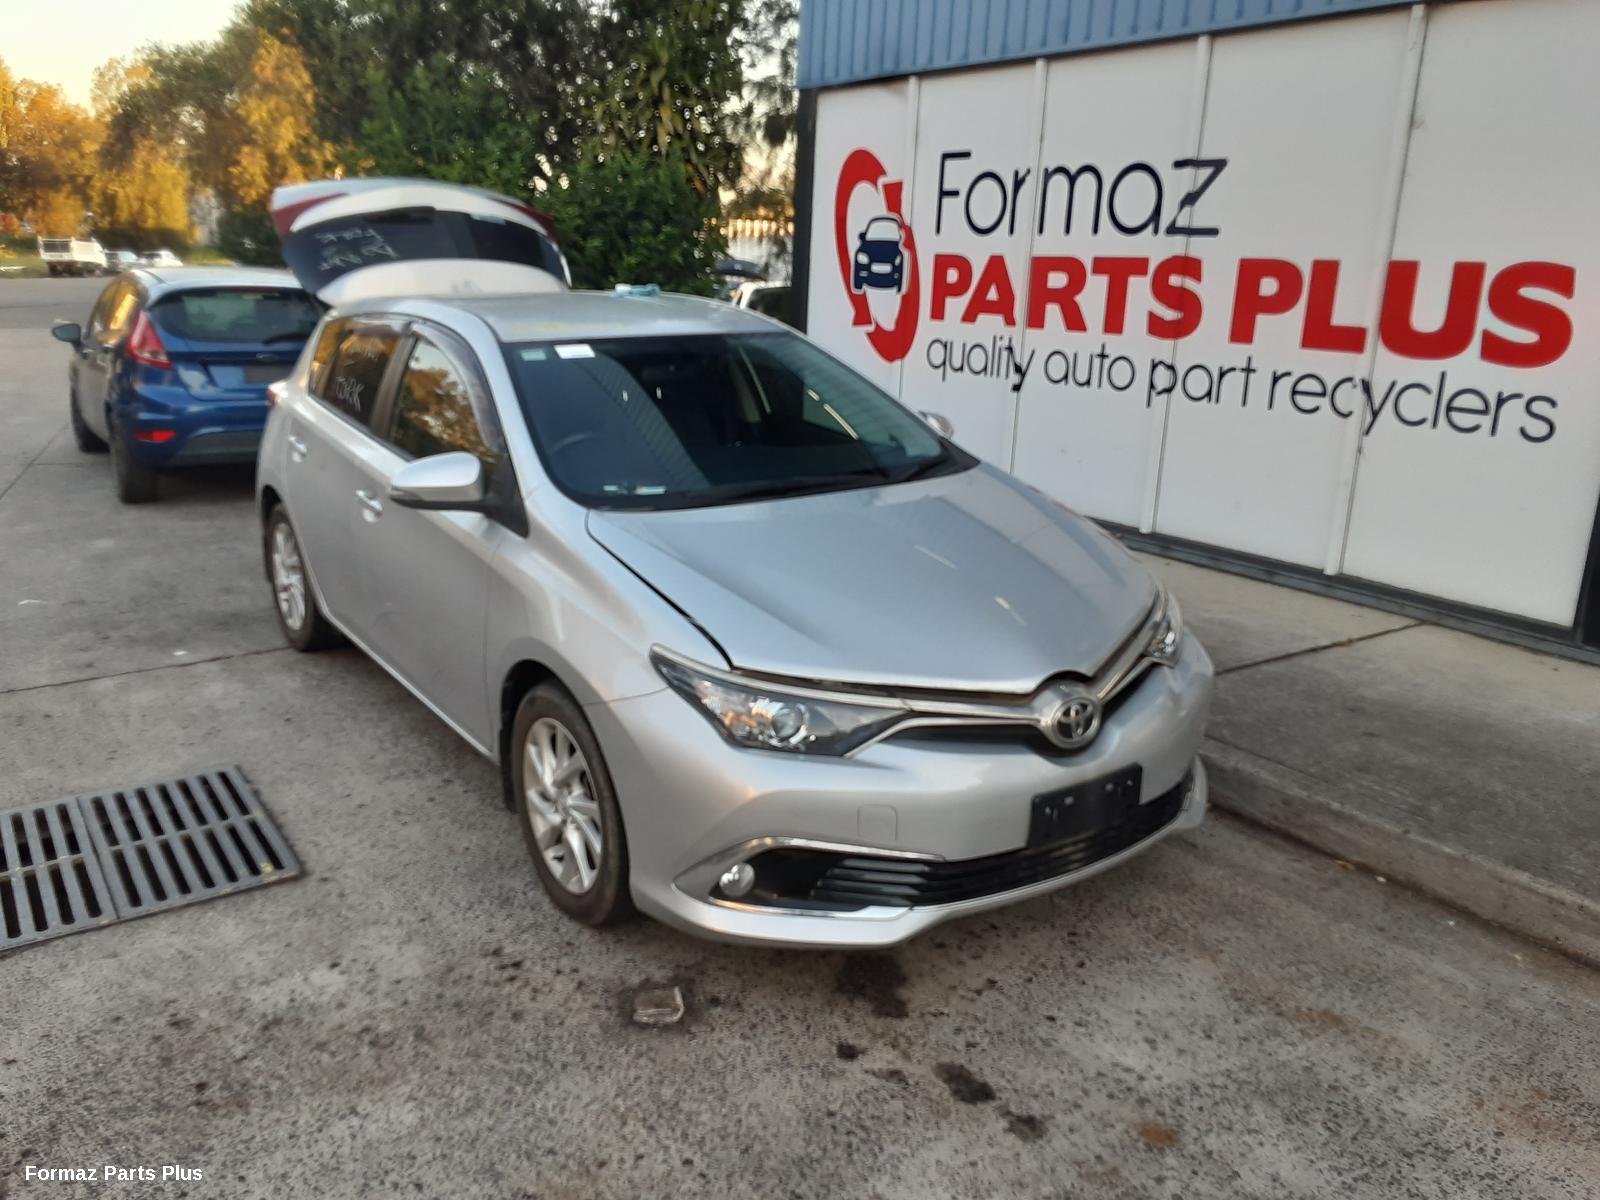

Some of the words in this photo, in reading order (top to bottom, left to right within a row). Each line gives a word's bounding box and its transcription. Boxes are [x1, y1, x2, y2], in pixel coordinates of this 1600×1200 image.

[935, 151, 1229, 237] Formaz
[930, 254, 1203, 340] PARTS
[1229, 258, 1577, 369] PLUS
[926, 335, 1034, 392] quality
[1043, 345, 1136, 392] auto
[1146, 355, 1257, 408] part
[1269, 371, 1558, 444] recyclers
